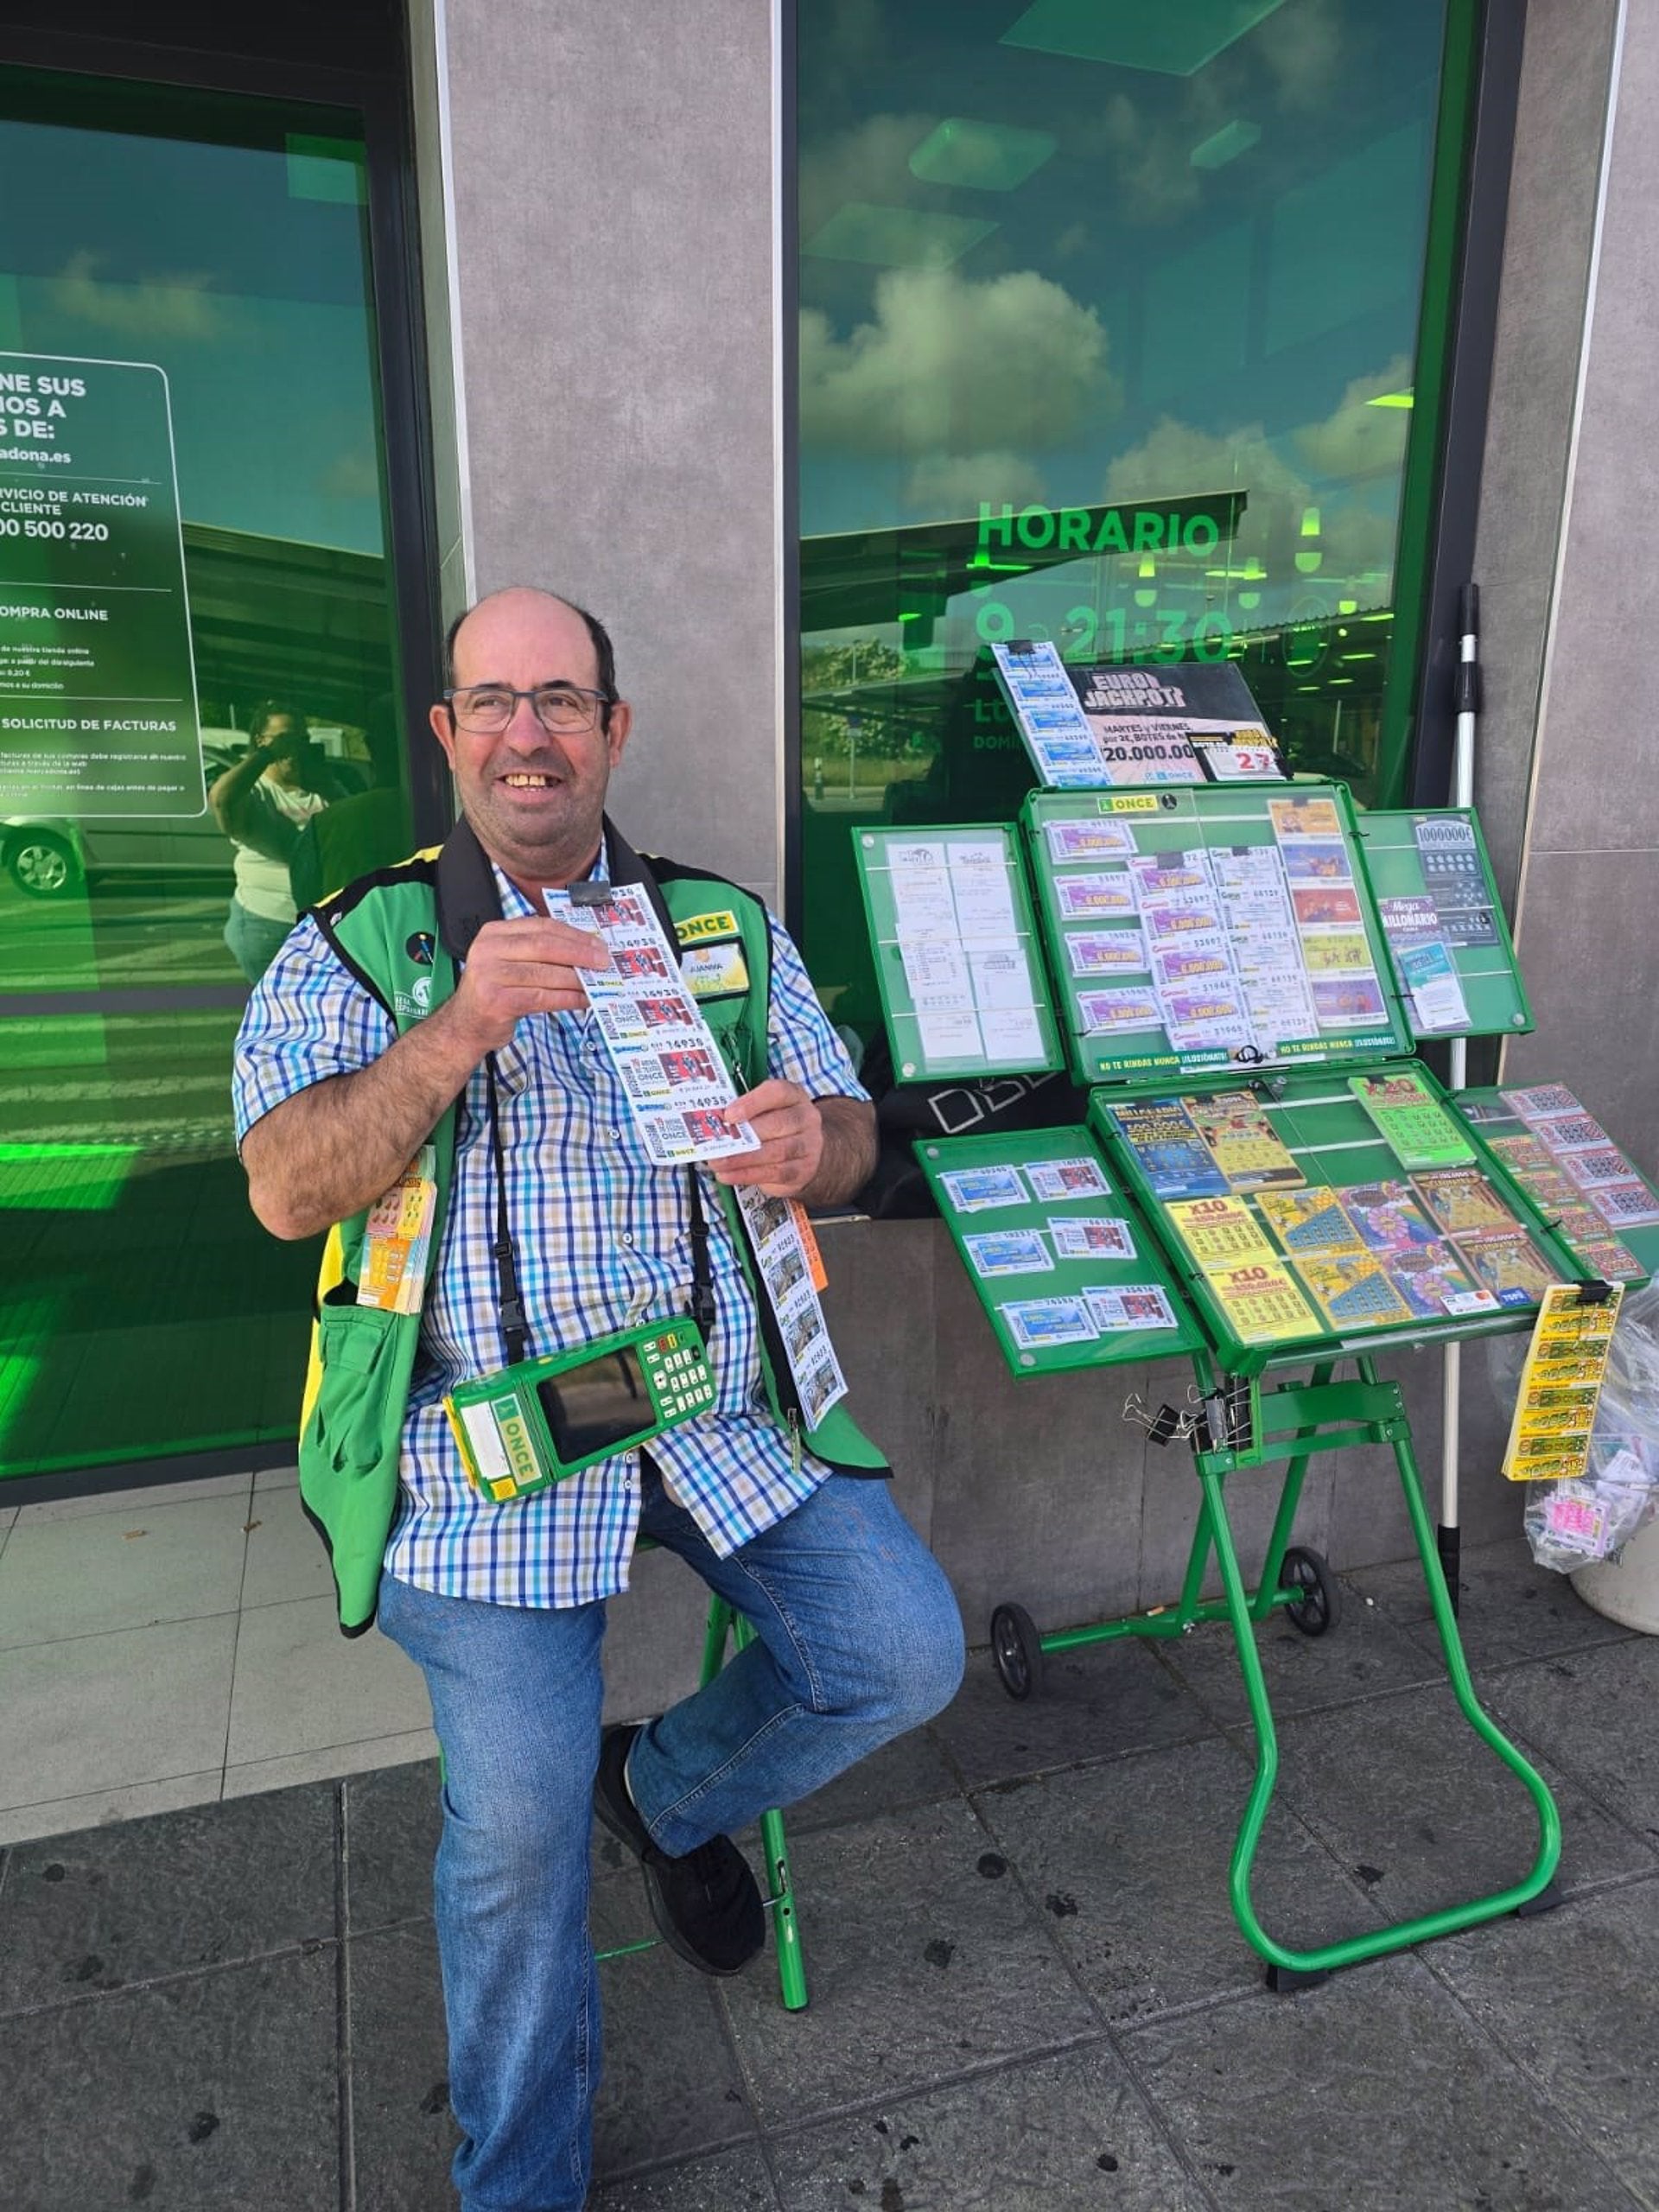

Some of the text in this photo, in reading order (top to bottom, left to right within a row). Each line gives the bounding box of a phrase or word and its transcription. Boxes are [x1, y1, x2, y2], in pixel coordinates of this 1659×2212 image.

[37, 376, 86, 397] SUS
[47, 400, 67, 417] A
[14, 419, 55, 439] DE:
[48, 491, 68, 502] DE
[72, 493, 147, 507] ATENCIÓN
[1, 502, 62, 515] CLIENTE
[24, 520, 65, 538] 500
[69, 522, 109, 541] 220
[978, 501, 1219, 556] HORARIO
[54, 608, 109, 621] ONLINE
[1064, 605, 1233, 664] 21:30
[2, 718, 176, 732] SOLICITUD DE FACTURAS
[1101, 744, 1194, 761] 20.000.00
[1115, 798, 1155, 810] ONCE
[676, 916, 731, 939] ONCE
[505, 1422, 535, 1478] ONCE
